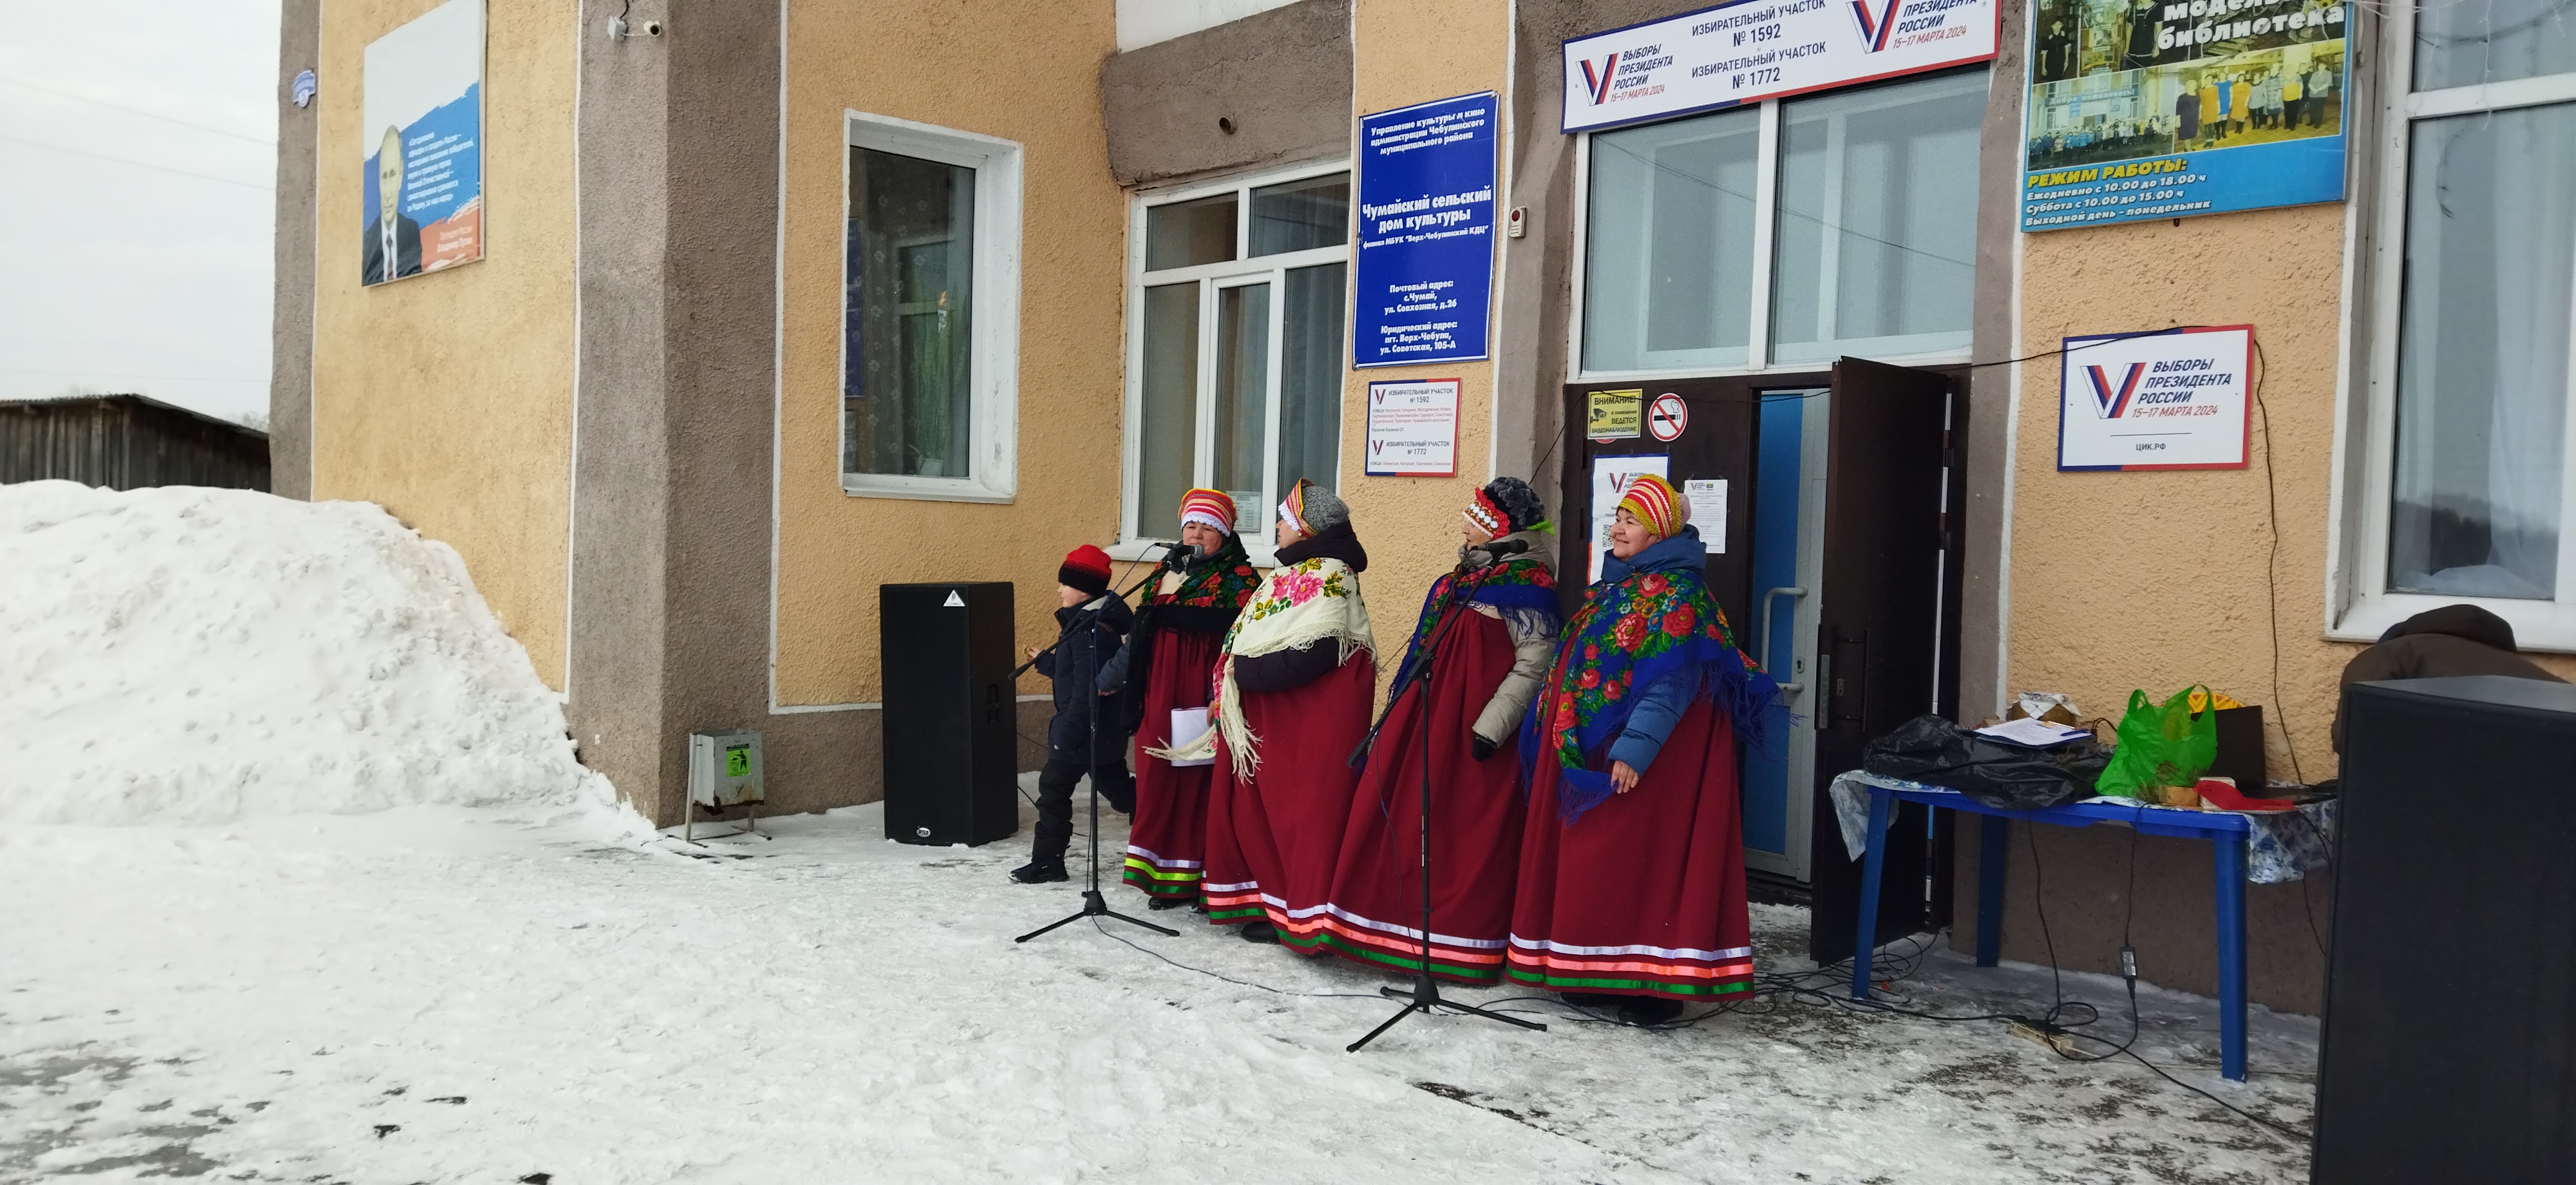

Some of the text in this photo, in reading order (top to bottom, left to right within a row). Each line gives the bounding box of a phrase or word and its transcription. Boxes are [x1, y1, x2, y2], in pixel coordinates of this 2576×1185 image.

[1692, 0, 1826, 36] ИЗБИРАТЕЛЬНЫЙ УЧАСТОК
[1903, 0, 1977, 17] ПРЕЗИДЕН
[1897, 14, 1945, 34] РОССИИ
[2157, 6, 2345, 50] библиотека
[1733, 23, 1781, 47] № 1592
[1916, 30, 1945, 44] МАРТА
[1945, 25, 1967, 39] 2024
[1622, 44, 1662, 61] ВЫБОРЫ
[1692, 41, 1826, 78] ИЗБИРАТЕЛЬНЫЙ УЧАСТОК
[1618, 55, 1673, 76] ПРЕЗИДЕНТА
[1614, 74, 1648, 90] РОССИИ
[1732, 66, 1781, 89] № 1772
[1628, 88, 1649, 99] МАРТА
[1650, 84, 1665, 95] 2024
[1371, 121, 1416, 136] Управление
[1417, 114, 1455, 128] культуры
[1464, 108, 1485, 118] кино
[1371, 119, 1484, 147] администрации Чебулинского
[1380, 131, 1473, 156] муниципального района
[2028, 158, 2188, 188] РЕЖИМ РАБОТЫ:
[2027, 187, 2092, 201] Ежедневно
[2096, 185, 2101, 194] с
[2105, 180, 2139, 193] 10.00
[2141, 179, 2157, 189] до
[2160, 174, 2196, 187] 18.00
[1363, 185, 1492, 221] Чумайский сельский
[2026, 202, 2073, 216] Суббота
[2084, 195, 2119, 207] 10.00
[2120, 194, 2136, 205] до
[2139, 189, 2175, 202] 15.00
[1379, 209, 1471, 234] дом культуры
[2025, 211, 2085, 227] Выходной
[2087, 210, 2116, 221] день
[2126, 200, 2211, 216] понедельник
[1363, 240, 1385, 250] филиал
[1385, 236, 1404, 245] МБУК
[1390, 280, 1454, 293] Почтовый адрес:
[1404, 291, 1437, 302] с.Чумай,
[1384, 299, 1457, 316] ул. Совхозная, д.26
[1381, 321, 1457, 335] Юридический адрес:
[1380, 341, 1456, 355] ул. Советская, 105-А
[2152, 358, 2215, 373] ВЫБОРЫ
[2145, 373, 2232, 389] ПРЕЗИДЕНТА
[1594, 395, 1636, 405] ВНИМАНИЕ!
[2137, 391, 2193, 404] РОССИИ
[2159, 406, 2192, 417] МАРТА
[2193, 405, 2219, 415] 2024
[2136, 442, 2166, 451] ЦИК.РФ
